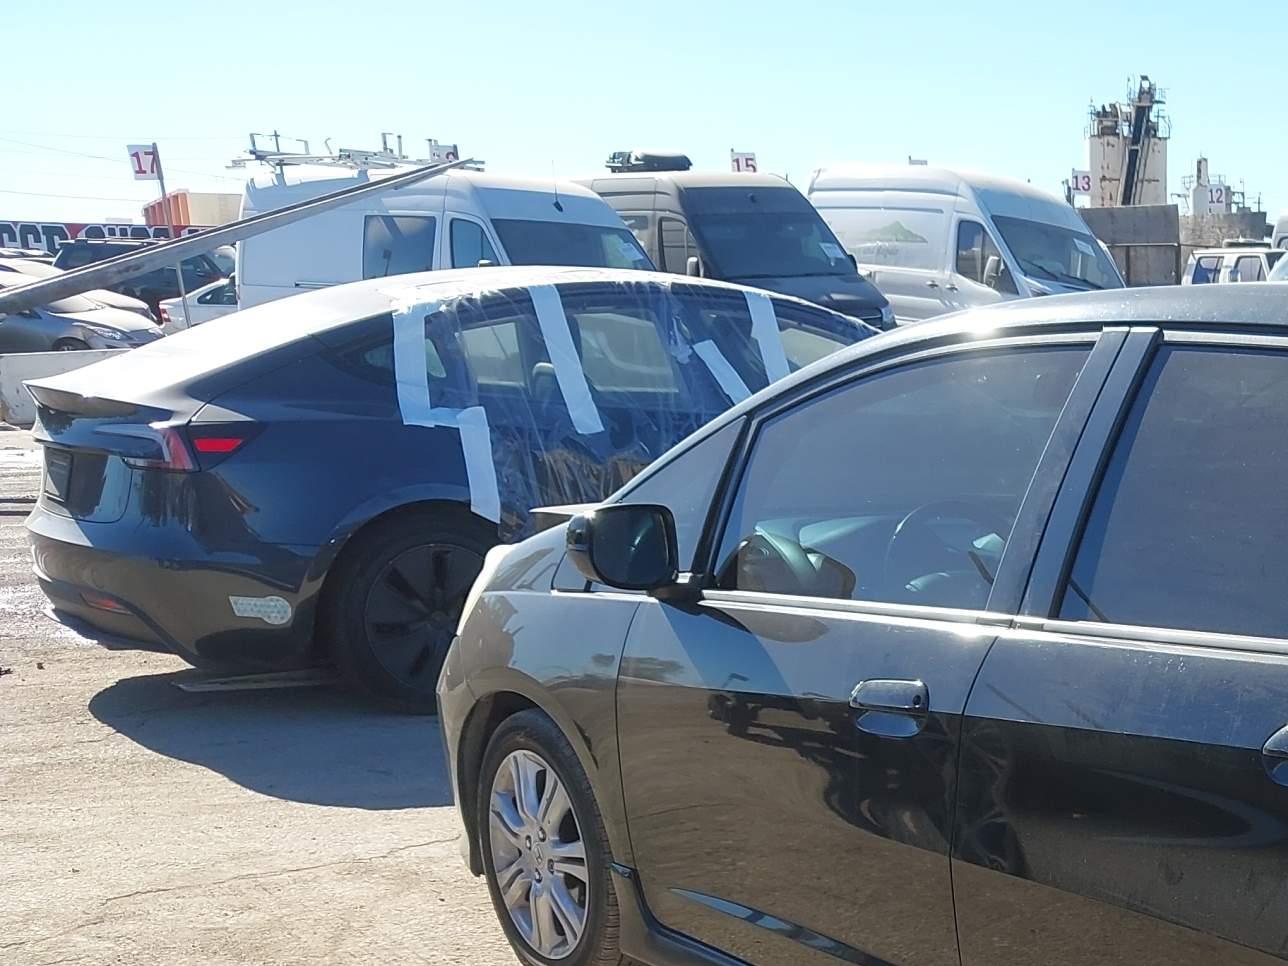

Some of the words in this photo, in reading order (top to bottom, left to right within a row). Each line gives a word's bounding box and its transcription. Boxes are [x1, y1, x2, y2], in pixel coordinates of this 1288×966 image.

[130, 151, 155, 174] 17
[732, 157, 757, 172] 15
[1072, 175, 1091, 192] 13
[1208, 187, 1224, 204] 12
